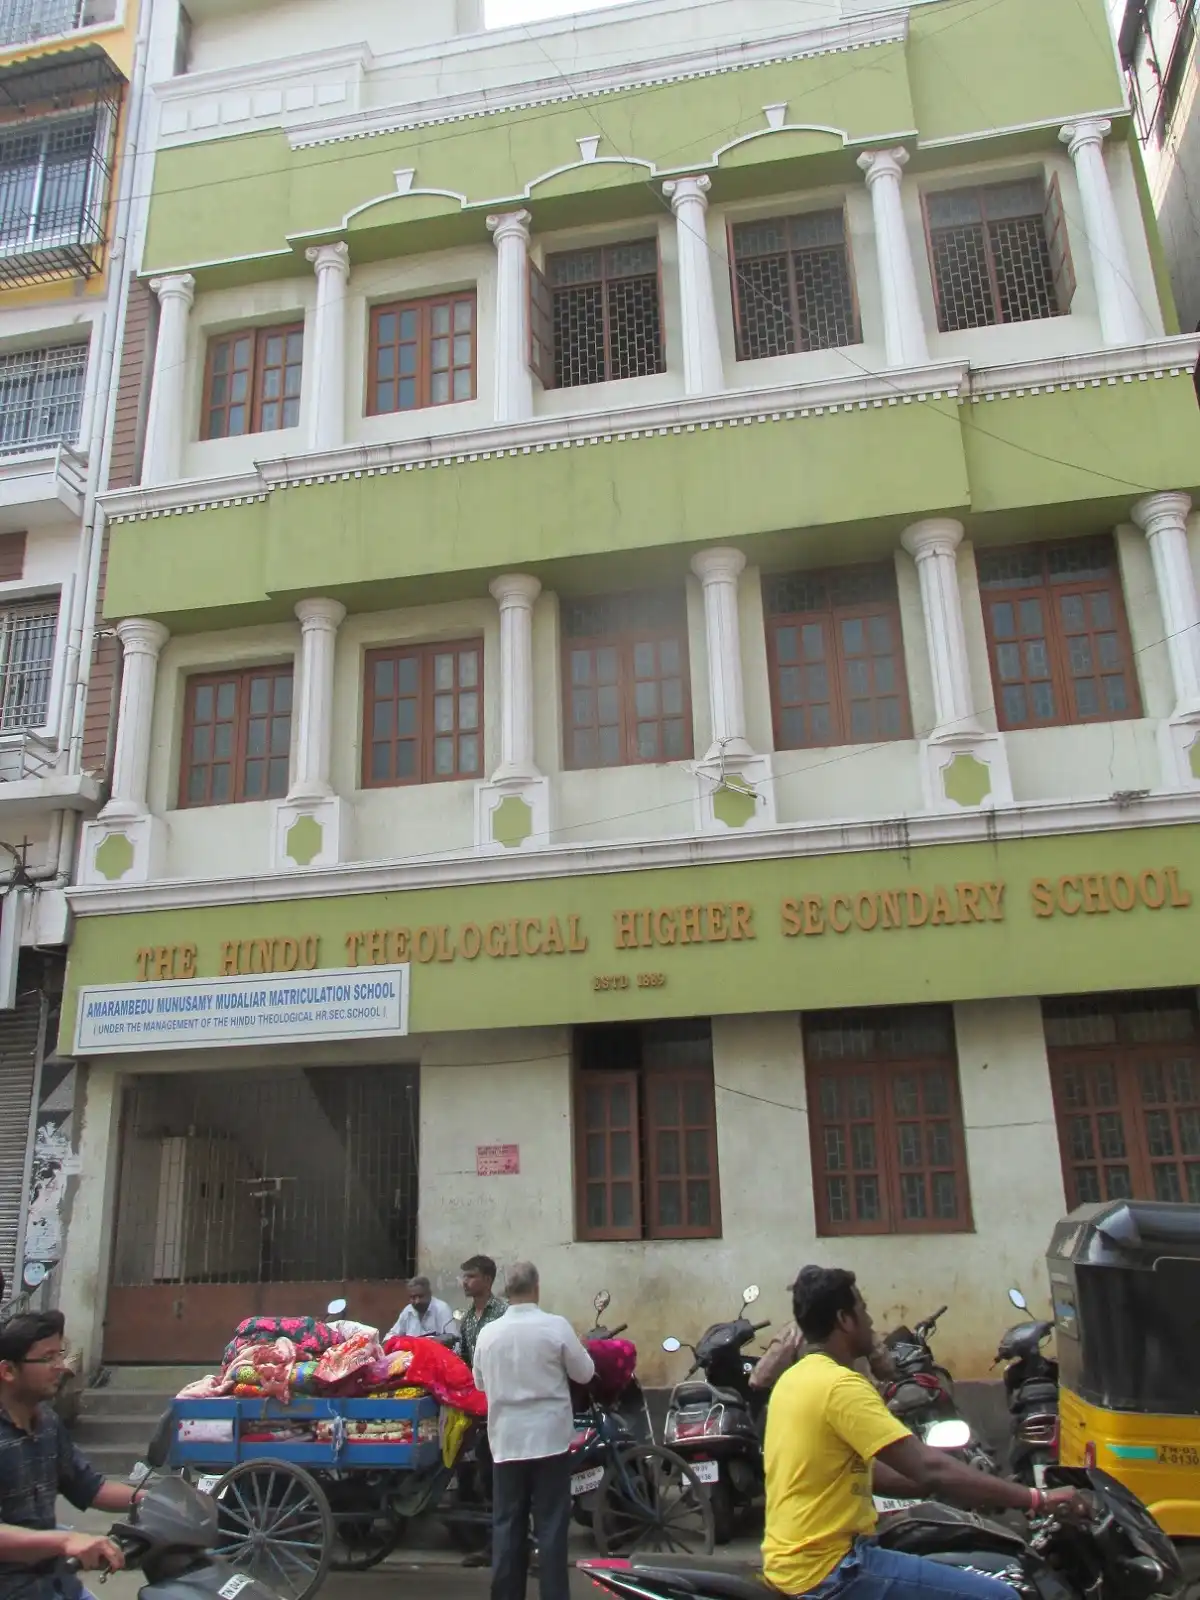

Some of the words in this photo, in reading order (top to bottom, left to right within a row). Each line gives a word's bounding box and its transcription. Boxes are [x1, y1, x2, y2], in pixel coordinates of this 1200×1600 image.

[136, 943, 197, 982] THE
[219, 934, 321, 976] HINDU
[345, 914, 588, 967] THEOLOGICAL
[614, 902, 756, 949] HIGHER
[780, 881, 1006, 937] SECONDARY
[1031, 867, 1192, 917] SCHOOL
[86, 998, 154, 1018] AMARAMBEDU
[156, 995, 213, 1013] MUNUSAMY
[215, 990, 267, 1009] MUDALIAR
[268, 985, 351, 1006] MATRICULATION
[353, 981, 396, 1001] SCHOOL
[126, 1021, 141, 1033] THE
[143, 1018, 199, 1032] MANAGEMENT
[201, 1017, 212, 1028] OF
[213, 1016, 229, 1028] THE
[230, 1015, 256, 1026] HINDU
[258, 1012, 313, 1025] THEOLOGICAL
